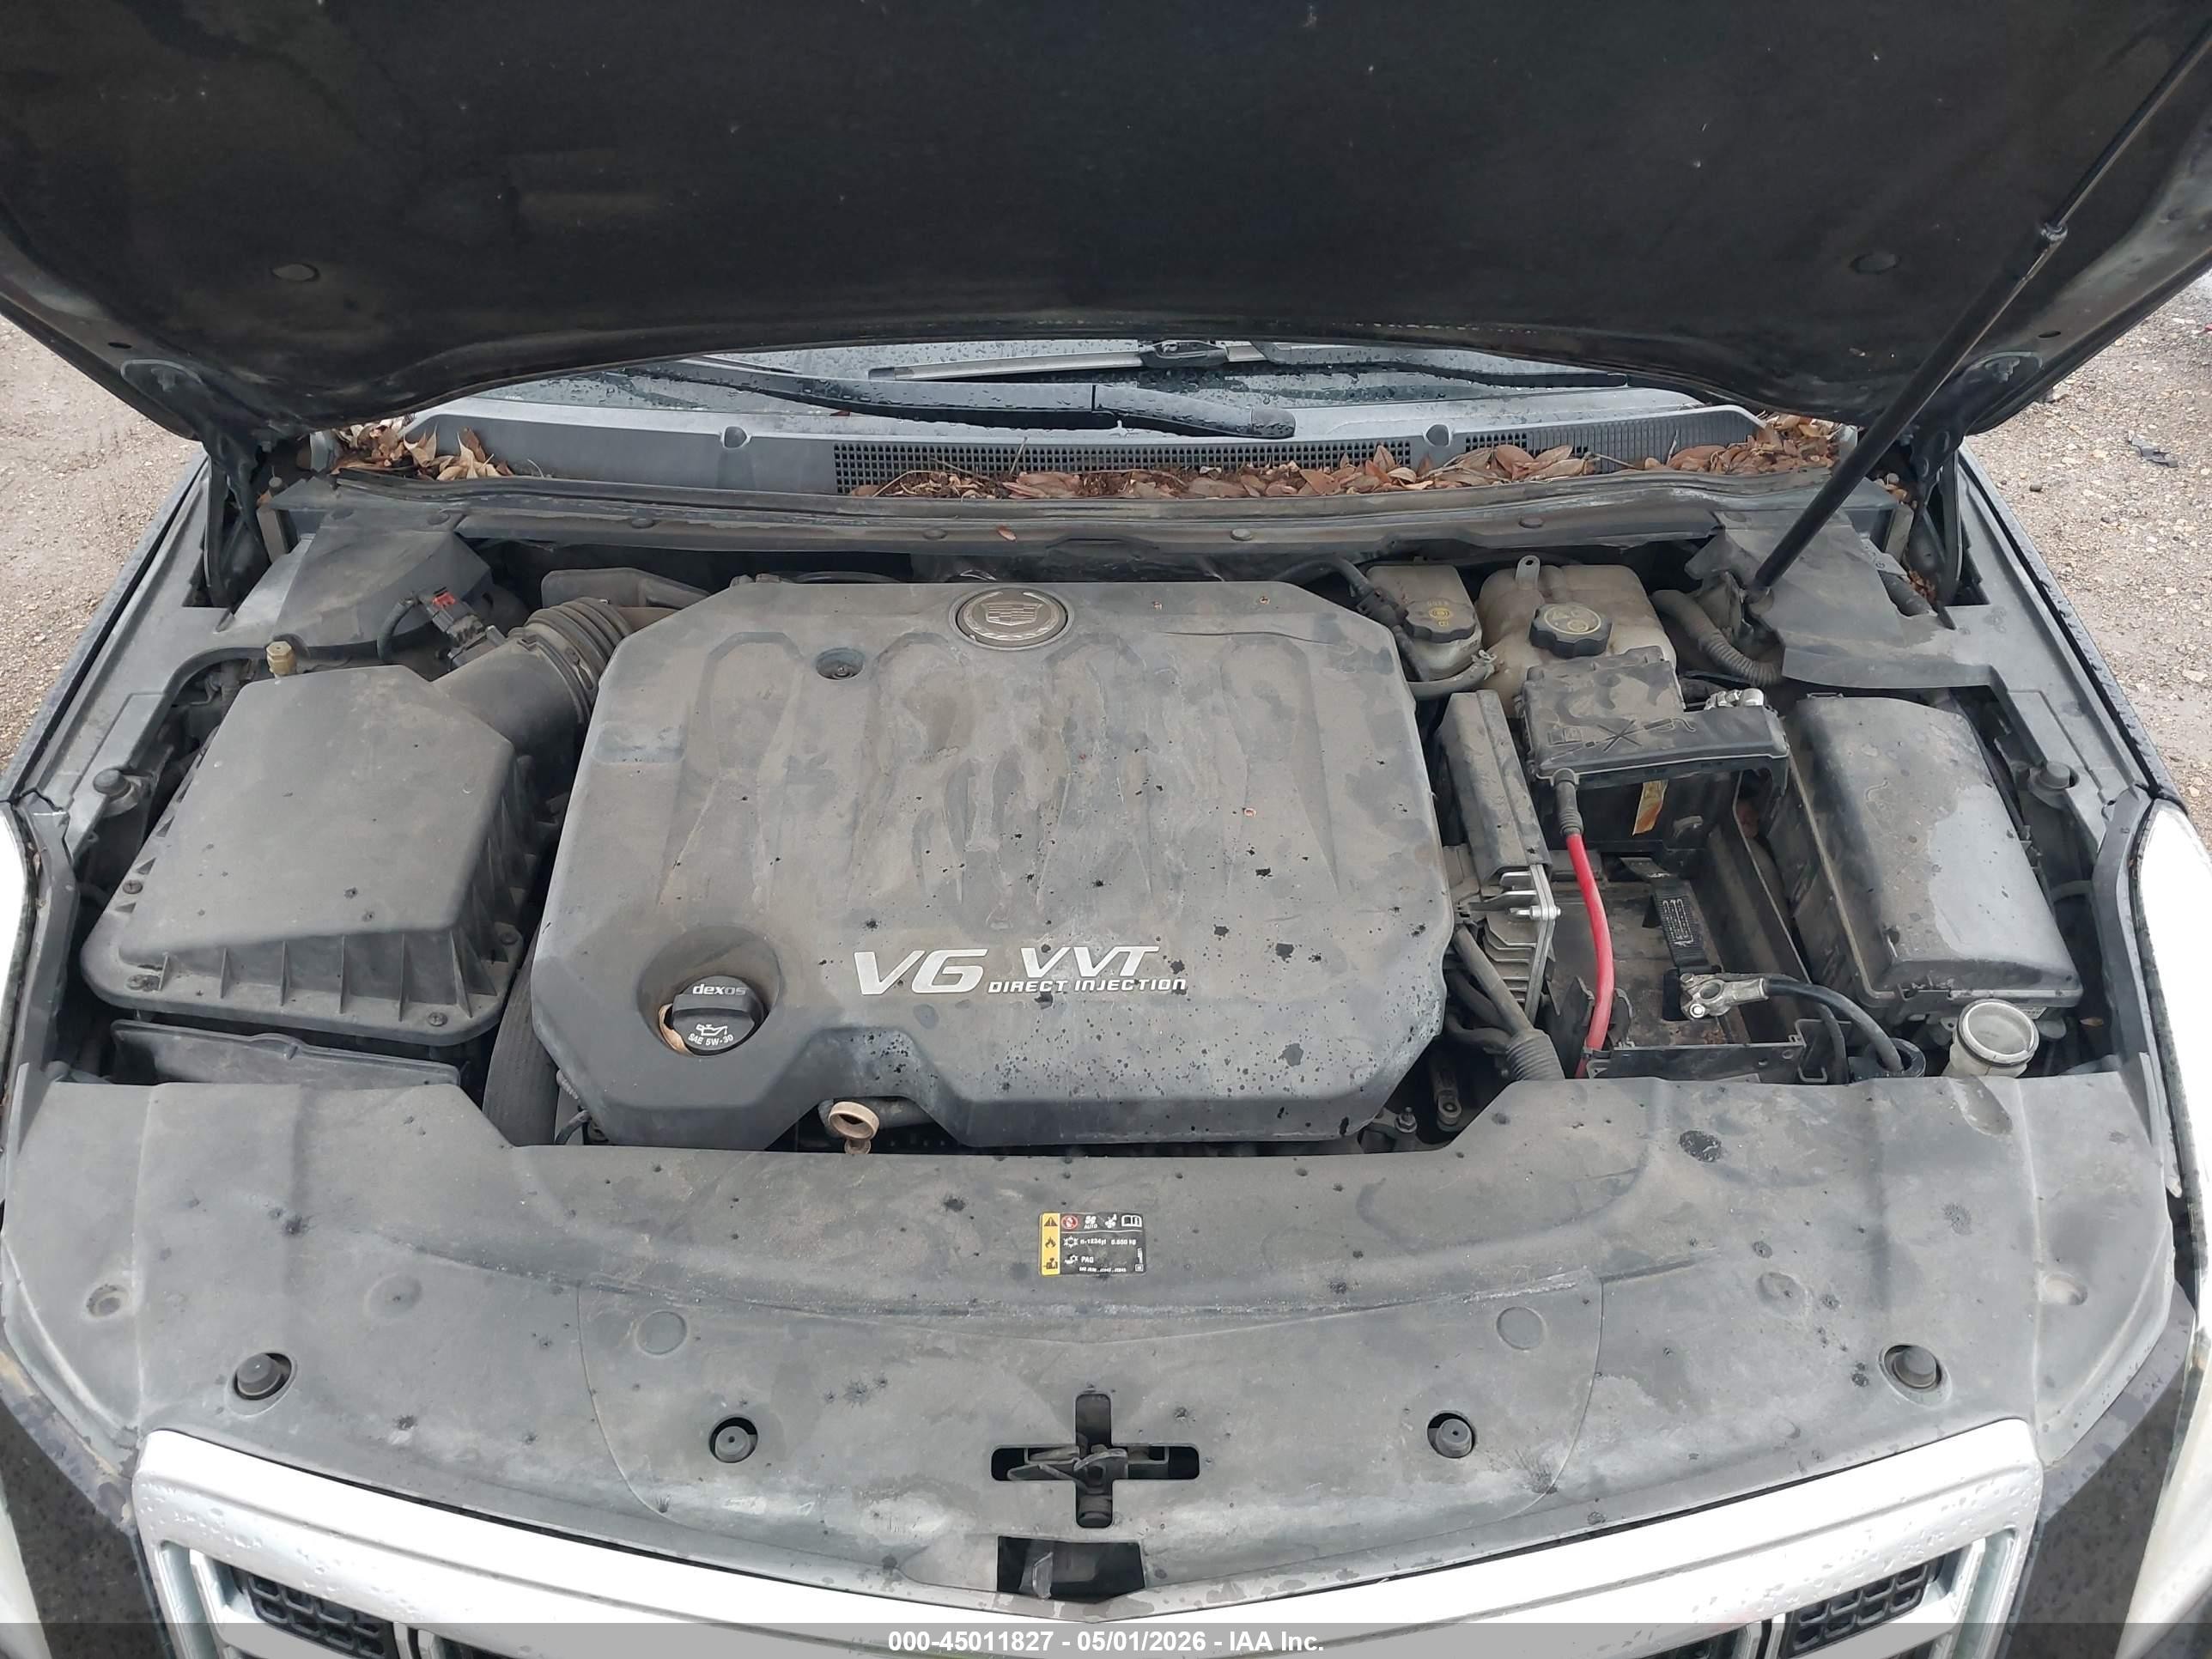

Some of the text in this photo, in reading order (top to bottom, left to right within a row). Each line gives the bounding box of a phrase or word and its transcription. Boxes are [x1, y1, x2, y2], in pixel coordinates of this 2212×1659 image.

[854, 945, 1160, 995] V6 VVT
[692, 983, 747, 996] dexos
[988, 978, 1187, 994] DIRECT INJECTION
[688, 1033, 734, 1047] SAE 5W-30
